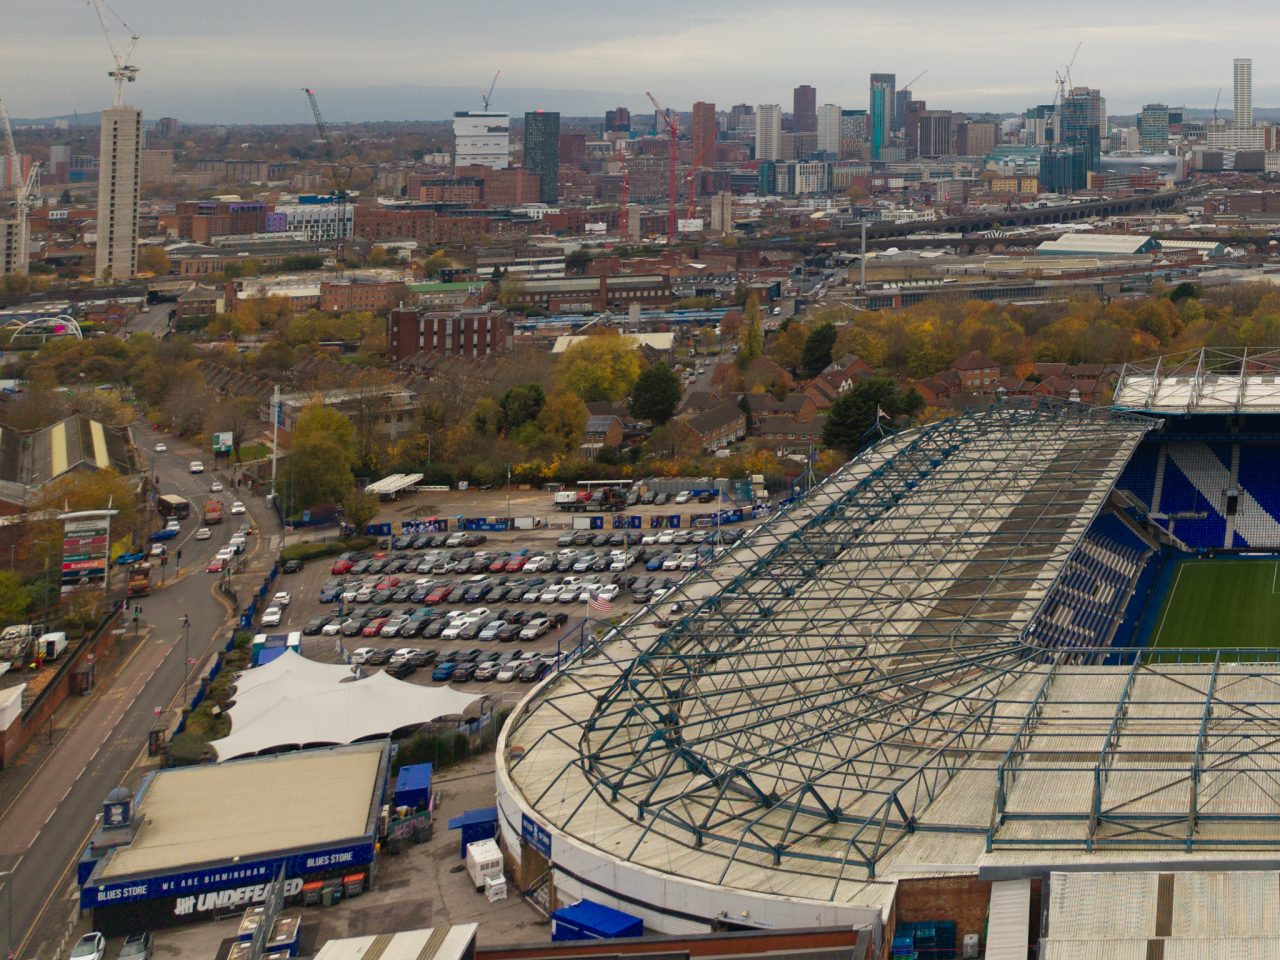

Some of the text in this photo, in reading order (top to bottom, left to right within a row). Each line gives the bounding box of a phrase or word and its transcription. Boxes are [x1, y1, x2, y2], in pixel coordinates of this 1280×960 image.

[306, 852, 353, 867] BLUES STORE
[162, 882, 175, 890] WE
[180, 878, 198, 887] ARE
[98, 885, 148, 901] BLUES STORE
[197, 878, 304, 911] UNDEFEAED
